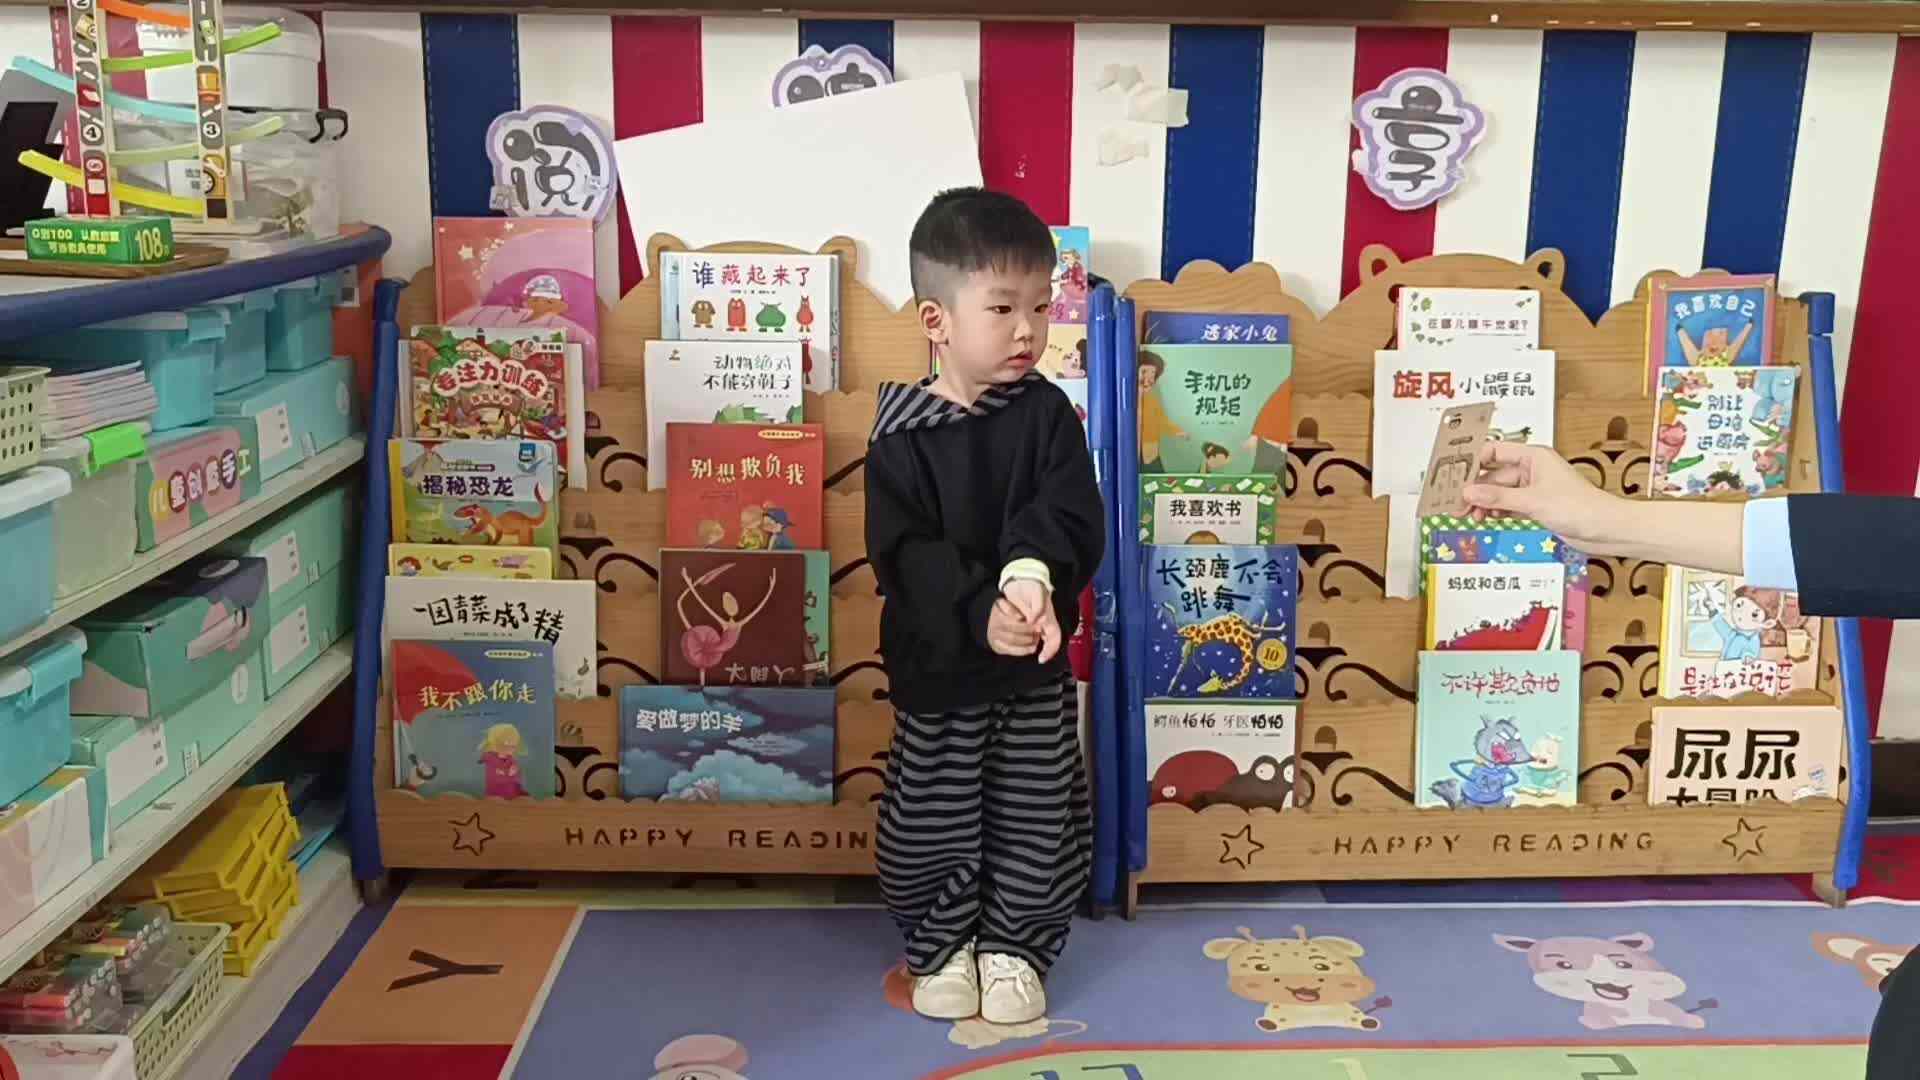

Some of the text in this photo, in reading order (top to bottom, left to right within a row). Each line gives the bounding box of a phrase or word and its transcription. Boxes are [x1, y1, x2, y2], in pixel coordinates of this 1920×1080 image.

[86, 126, 97, 139] 4
[206, 124, 216, 136] 3
[1372, 86, 1464, 192] 享
[692, 261, 811, 288] 谁藏起来了
[1184, 370, 1251, 393] 手机的
[1393, 370, 1535, 399] 旋风小鼹鼠
[1195, 396, 1241, 416] 规矩
[689, 453, 805, 485] 别想欺负我
[423, 474, 514, 497] 揭秘恐龙
[1169, 500, 1242, 517] 我喜欢书
[1156, 554, 1282, 587] 长颈鹿不会
[1448, 576, 1520, 590] 蚂蚁和西瓜
[1181, 585, 1251, 618] 跳舞
[418, 679, 537, 710] 我不跟你走
[636, 709, 743, 733] 爱做梦的羊
[1667, 728, 1799, 779] 尿尿
[565, 827, 868, 848] HAPPY READIN
[1334, 832, 1655, 854] HAPPY READING
[385, 949, 503, 992] Y
